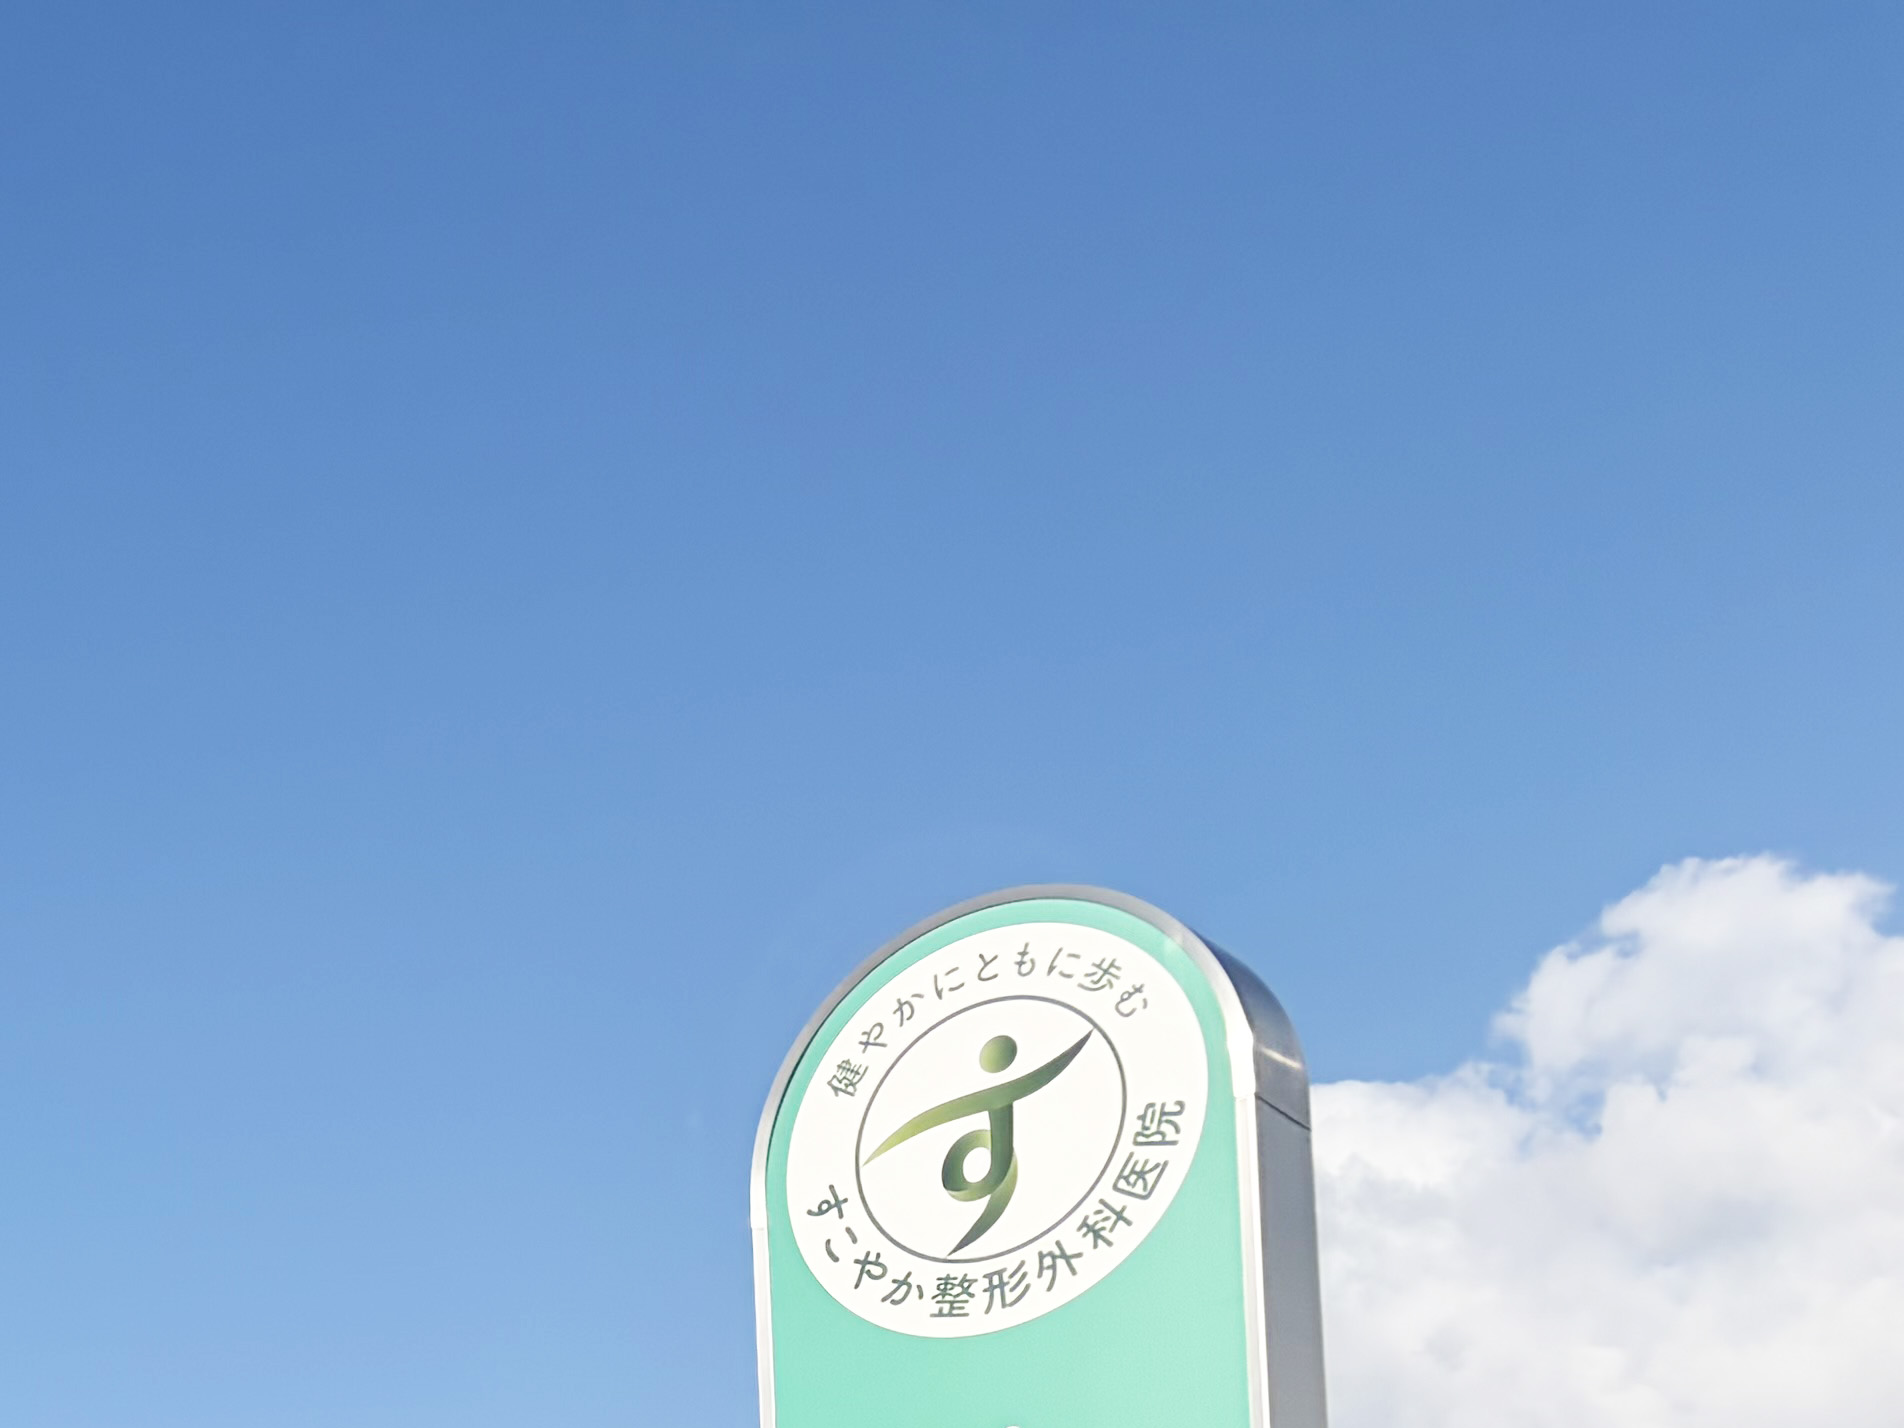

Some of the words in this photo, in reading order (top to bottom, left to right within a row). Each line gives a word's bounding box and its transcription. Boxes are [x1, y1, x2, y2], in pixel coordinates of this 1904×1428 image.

[827, 942, 1148, 1099] 健やかにともに歩む
[806, 1099, 1186, 1319] すこやか整形外科医院
